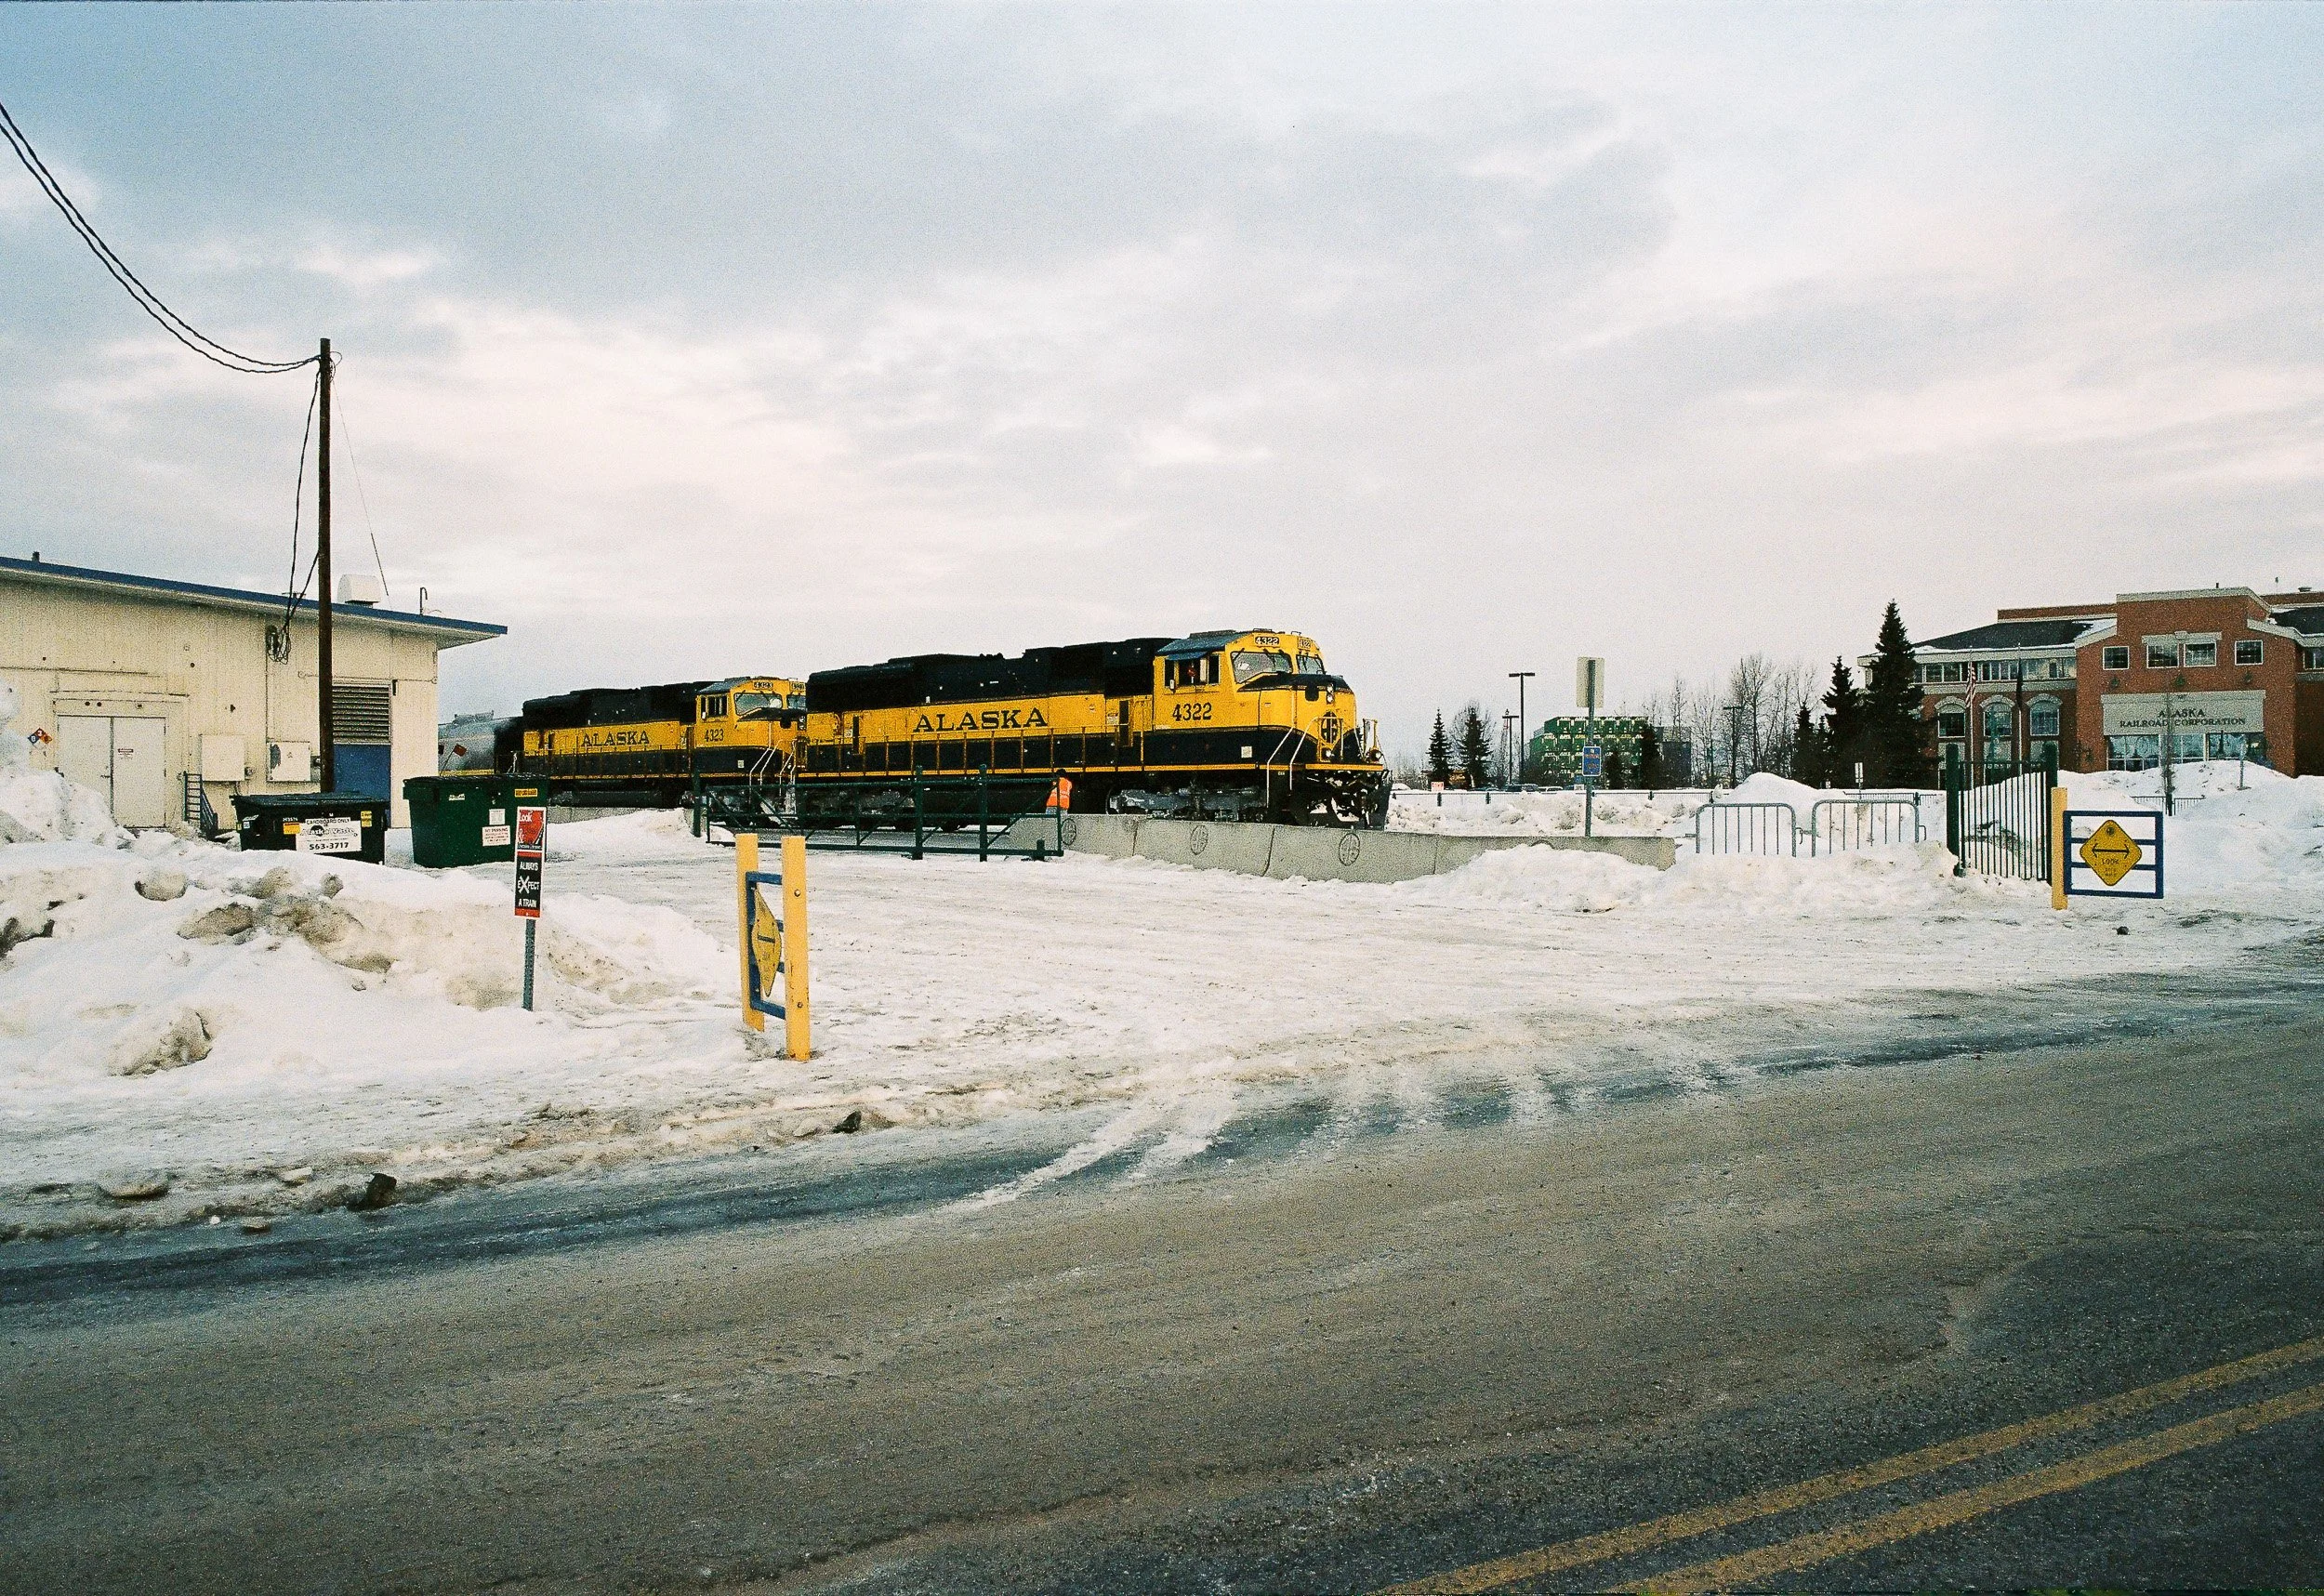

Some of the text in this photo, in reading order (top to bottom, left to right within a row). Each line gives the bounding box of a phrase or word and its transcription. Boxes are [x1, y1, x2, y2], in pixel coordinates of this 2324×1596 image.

[1256, 637, 1279, 645] 4322
[1172, 702, 1212, 721] 4322
[913, 707, 1049, 732] ALASKA
[2119, 717, 2246, 728] RAILROAD CORPORATION
[581, 730, 650, 747] ALASKA
[704, 728, 724, 743] 4323
[309, 842, 350, 851] 563-3717
[519, 861, 539, 871] ALWAYS
[518, 899, 537, 908] A TRAIN
